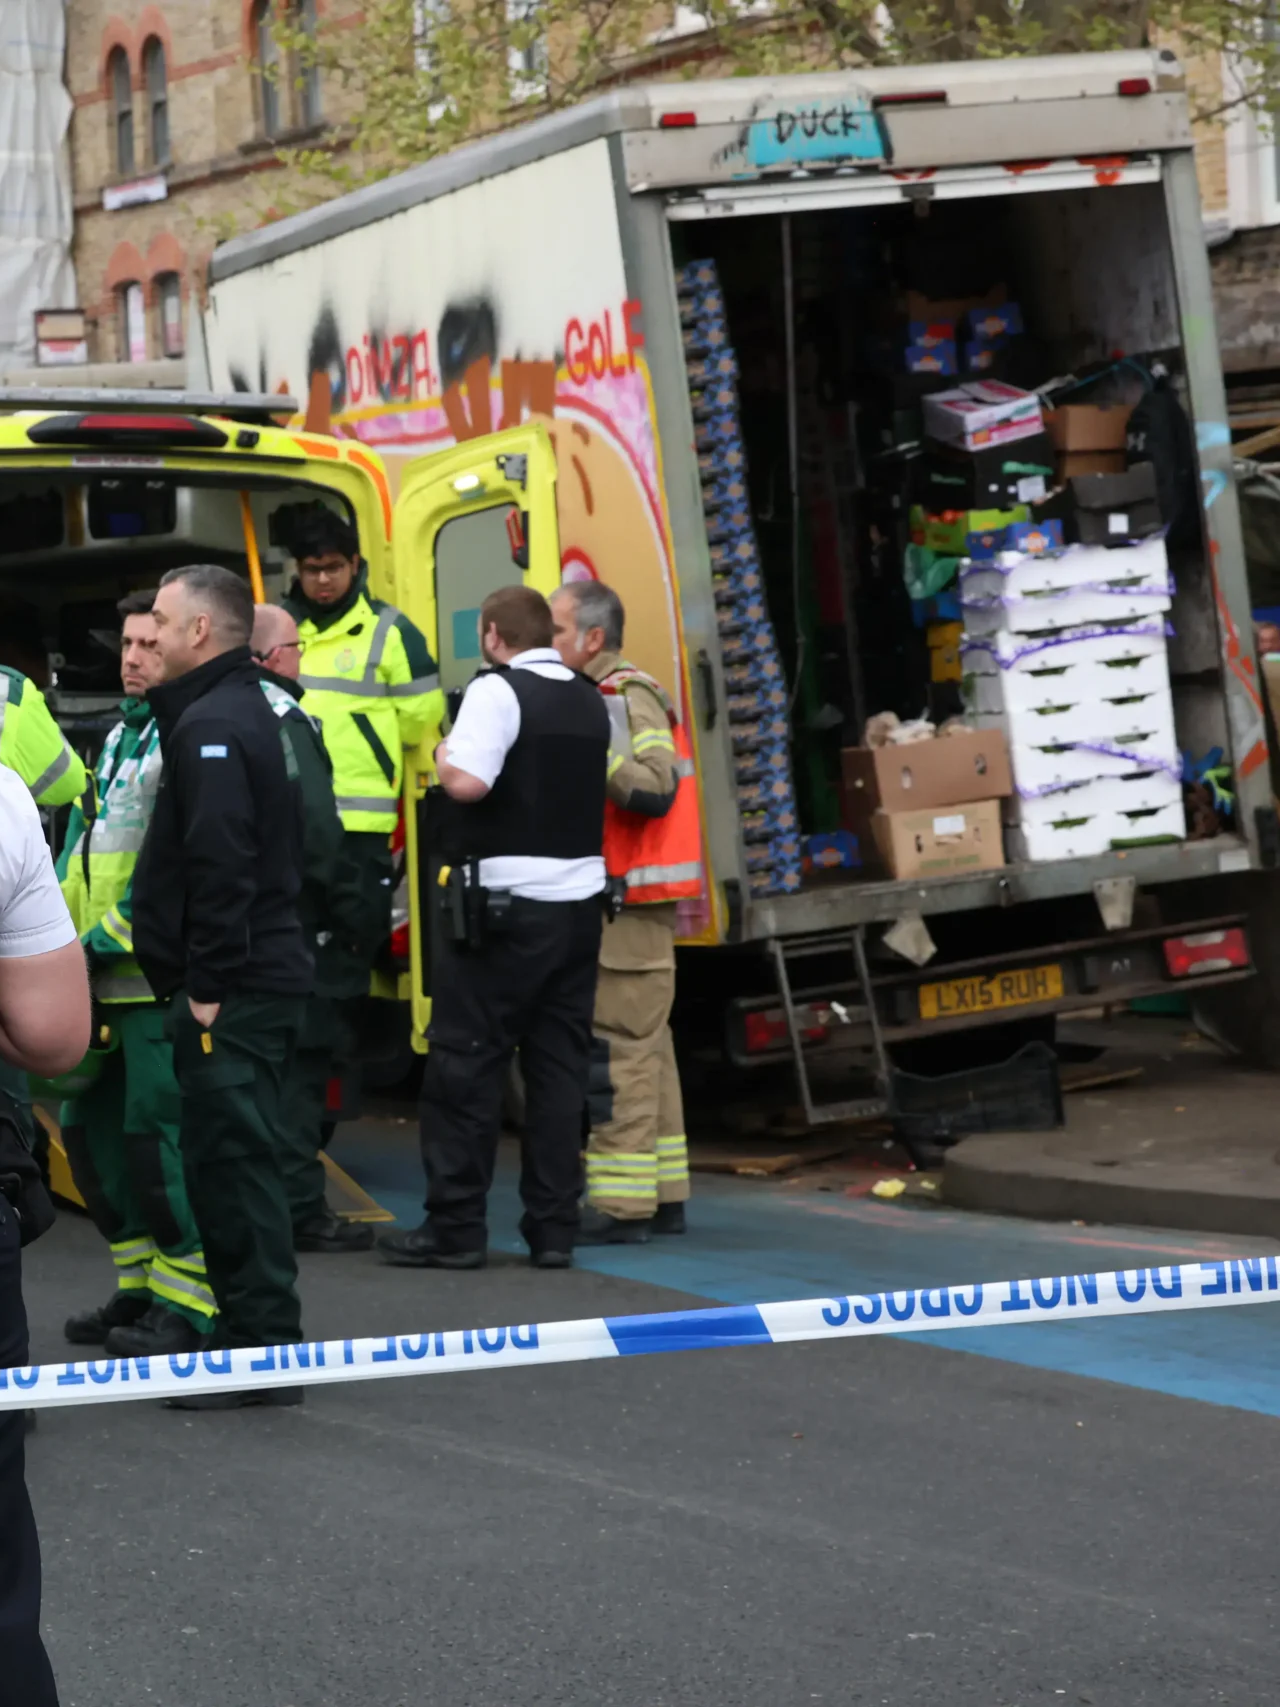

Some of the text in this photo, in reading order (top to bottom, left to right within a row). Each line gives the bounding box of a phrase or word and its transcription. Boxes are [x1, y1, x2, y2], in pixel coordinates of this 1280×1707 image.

[776, 103, 859, 145] DUCK
[564, 297, 646, 386] GOLF
[936, 969, 1048, 1012] LX15 RUH
